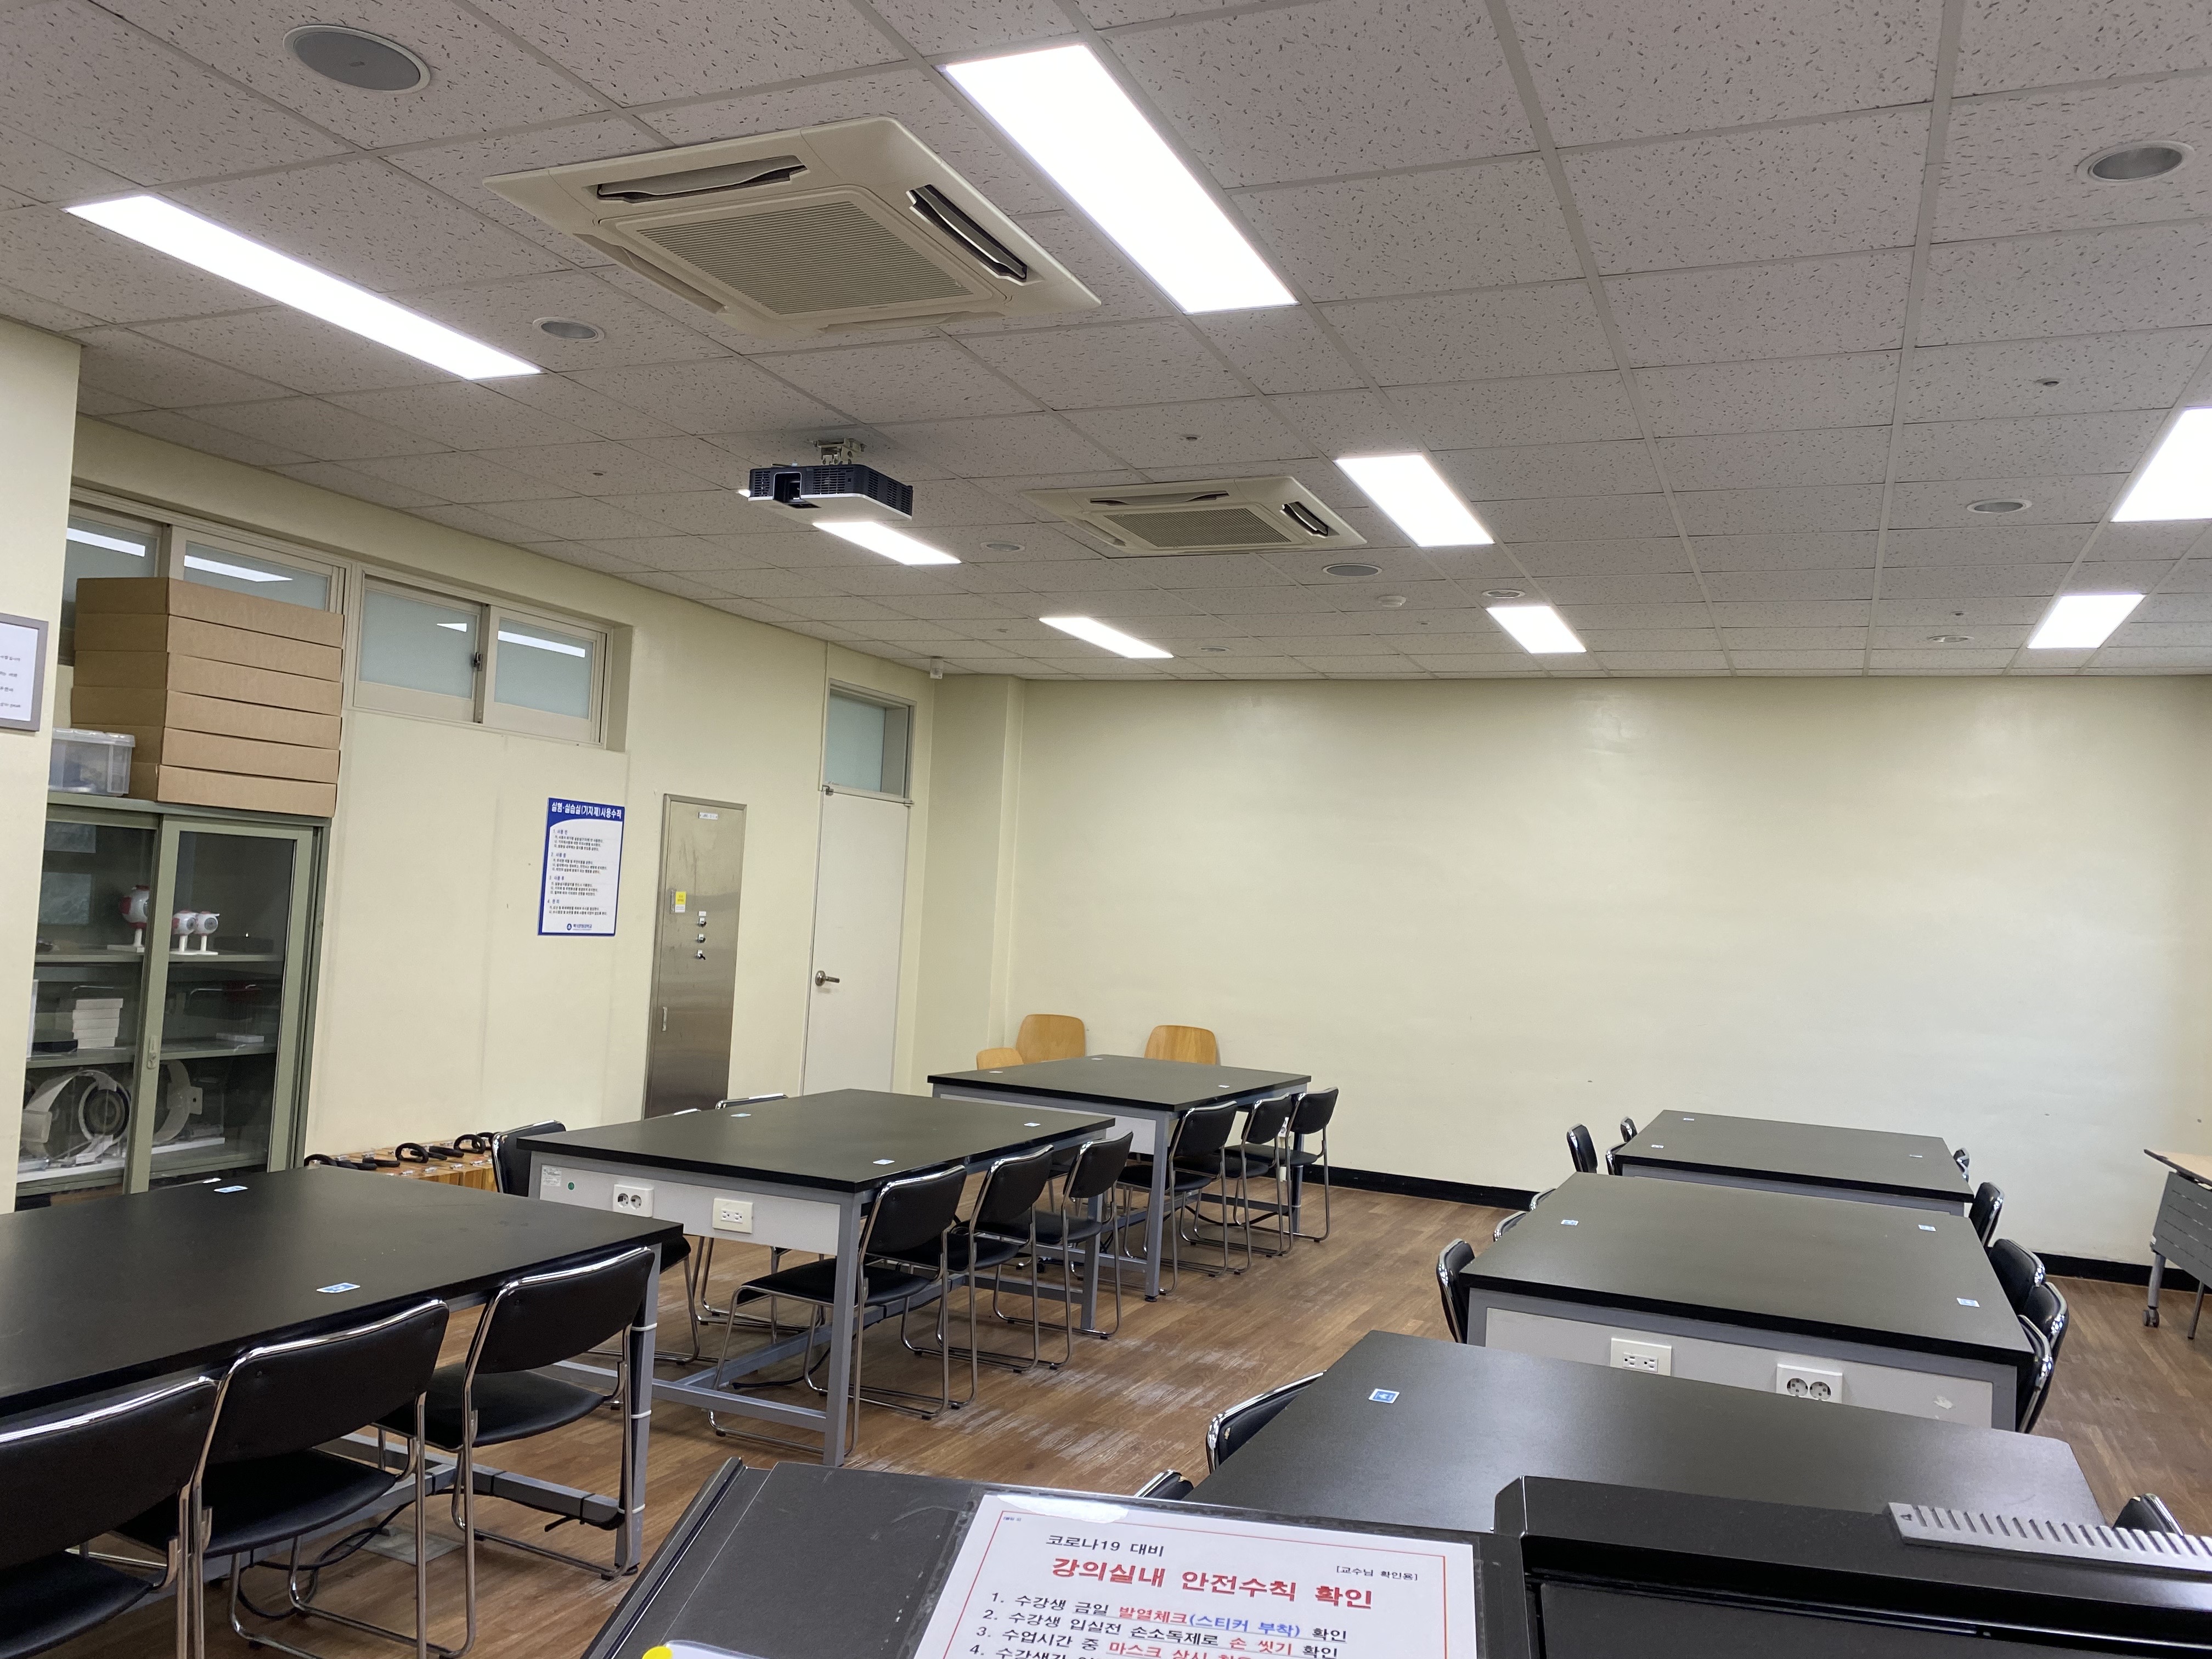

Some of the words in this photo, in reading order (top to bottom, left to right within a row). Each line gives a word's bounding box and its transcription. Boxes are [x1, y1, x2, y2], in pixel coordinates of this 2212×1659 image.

[1046, 1535, 1120, 1552] 코로나19
[1130, 1543, 1164, 1557] 대비
[1052, 1557, 1166, 1588] 강의실내
[1181, 1570, 1296, 1602] 안전수칙
[1315, 1584, 1373, 1610] 확인
[1336, 1565, 1374, 1577] [교수님
[1380, 1570, 1418, 1582] 확인용]
[991, 1592, 1005, 1603] 1.
[1015, 1595, 1066, 1611] 수강생
[1075, 1601, 1109, 1616] 금일
[1258, 1622, 1301, 1638] 부착)
[1312, 1627, 1347, 1643] 확인
[969, 1644, 984, 1656] 4.
[976, 1627, 991, 1637] 3.
[1002, 1629, 1073, 1647] 수업시간
[1081, 1638, 1099, 1651] 중
[1108, 1641, 1162, 1658] 마스크
[983, 1610, 998, 1621] 2.
[1008, 1612, 1061, 1628] 수강생
[1070, 1618, 1121, 1635] 입실전
[1130, 1625, 1219, 1646] 손소독제로
[1230, 1638, 1246, 1651] 손
[1258, 1640, 1293, 1656] 씻기
[1302, 1645, 1337, 1659] 확인
